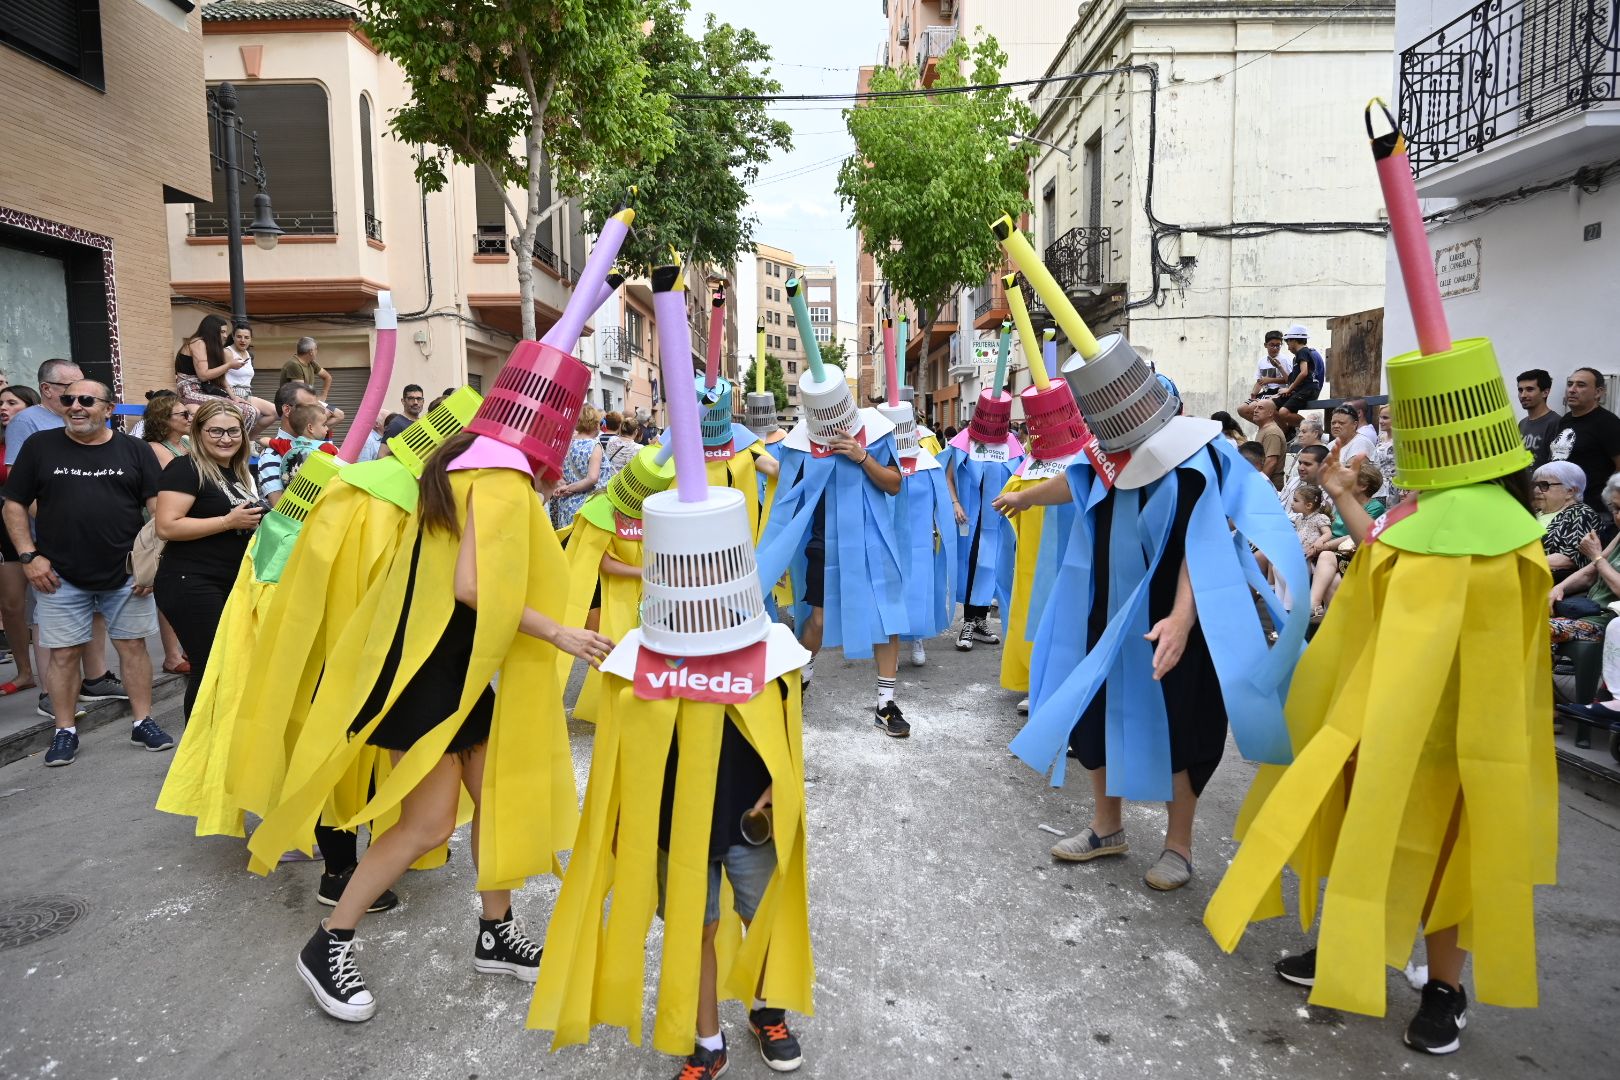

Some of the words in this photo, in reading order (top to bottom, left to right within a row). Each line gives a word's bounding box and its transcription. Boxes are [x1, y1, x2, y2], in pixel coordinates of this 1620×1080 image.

[1440, 279, 1451, 287] CALLE
[705, 449, 731, 457] eda
[1044, 467, 1061, 475] VERD
[645, 666, 753, 694] vileda
